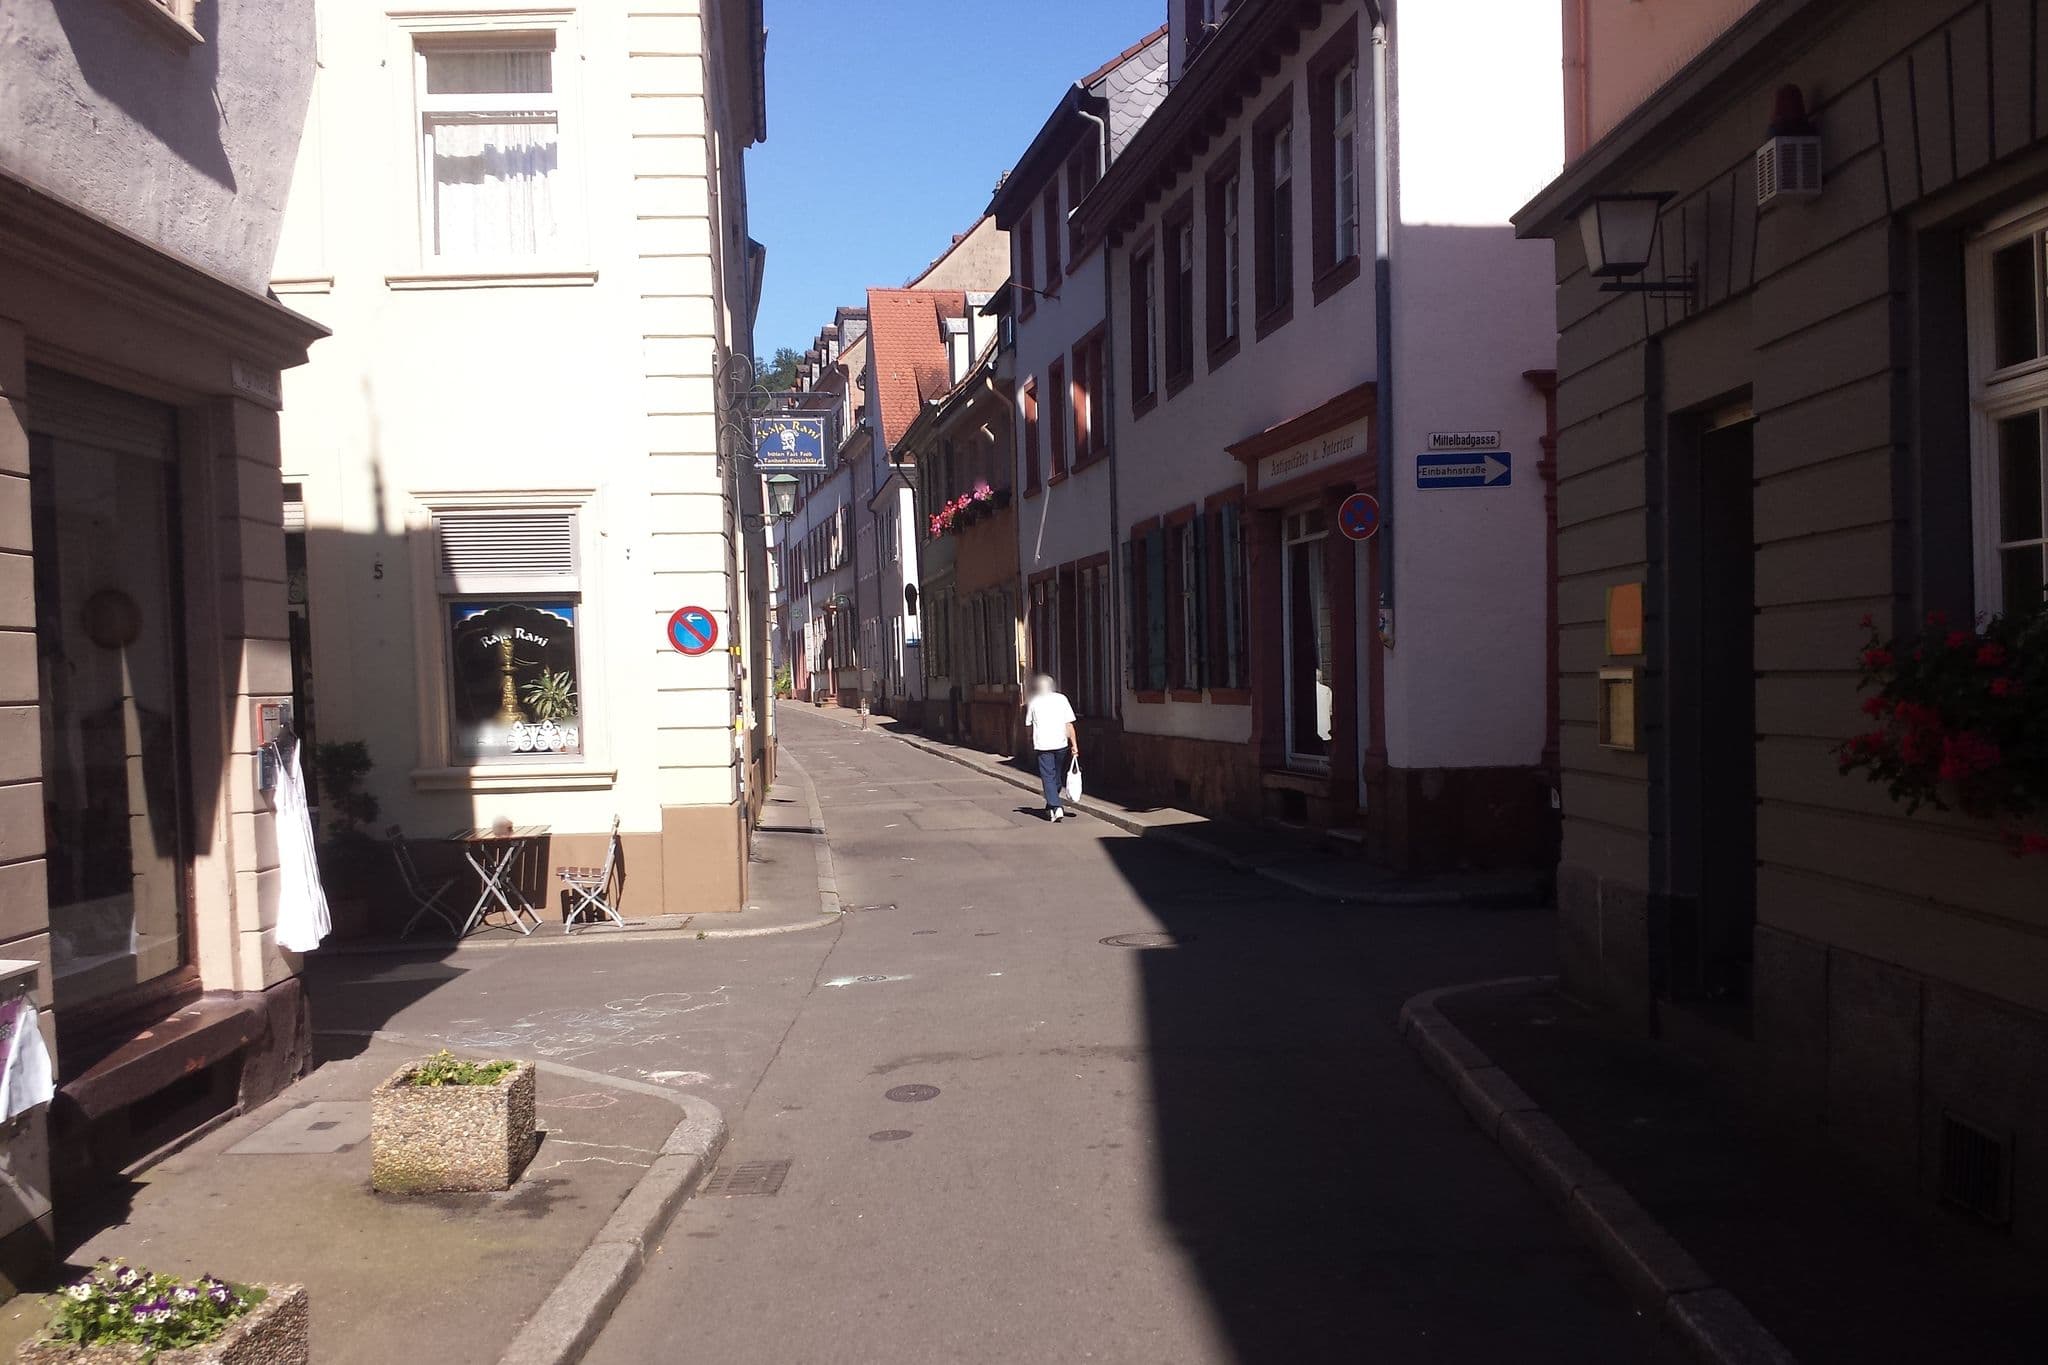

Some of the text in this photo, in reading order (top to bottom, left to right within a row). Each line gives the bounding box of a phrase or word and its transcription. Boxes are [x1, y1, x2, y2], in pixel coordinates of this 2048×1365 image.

[792, 420, 821, 440] Rani
[1432, 434, 1497, 448] Mittelbadgasse
[1421, 465, 1487, 477] Einbahnstraße
[374, 564, 384, 580] 5
[514, 626, 549, 648] Rani
